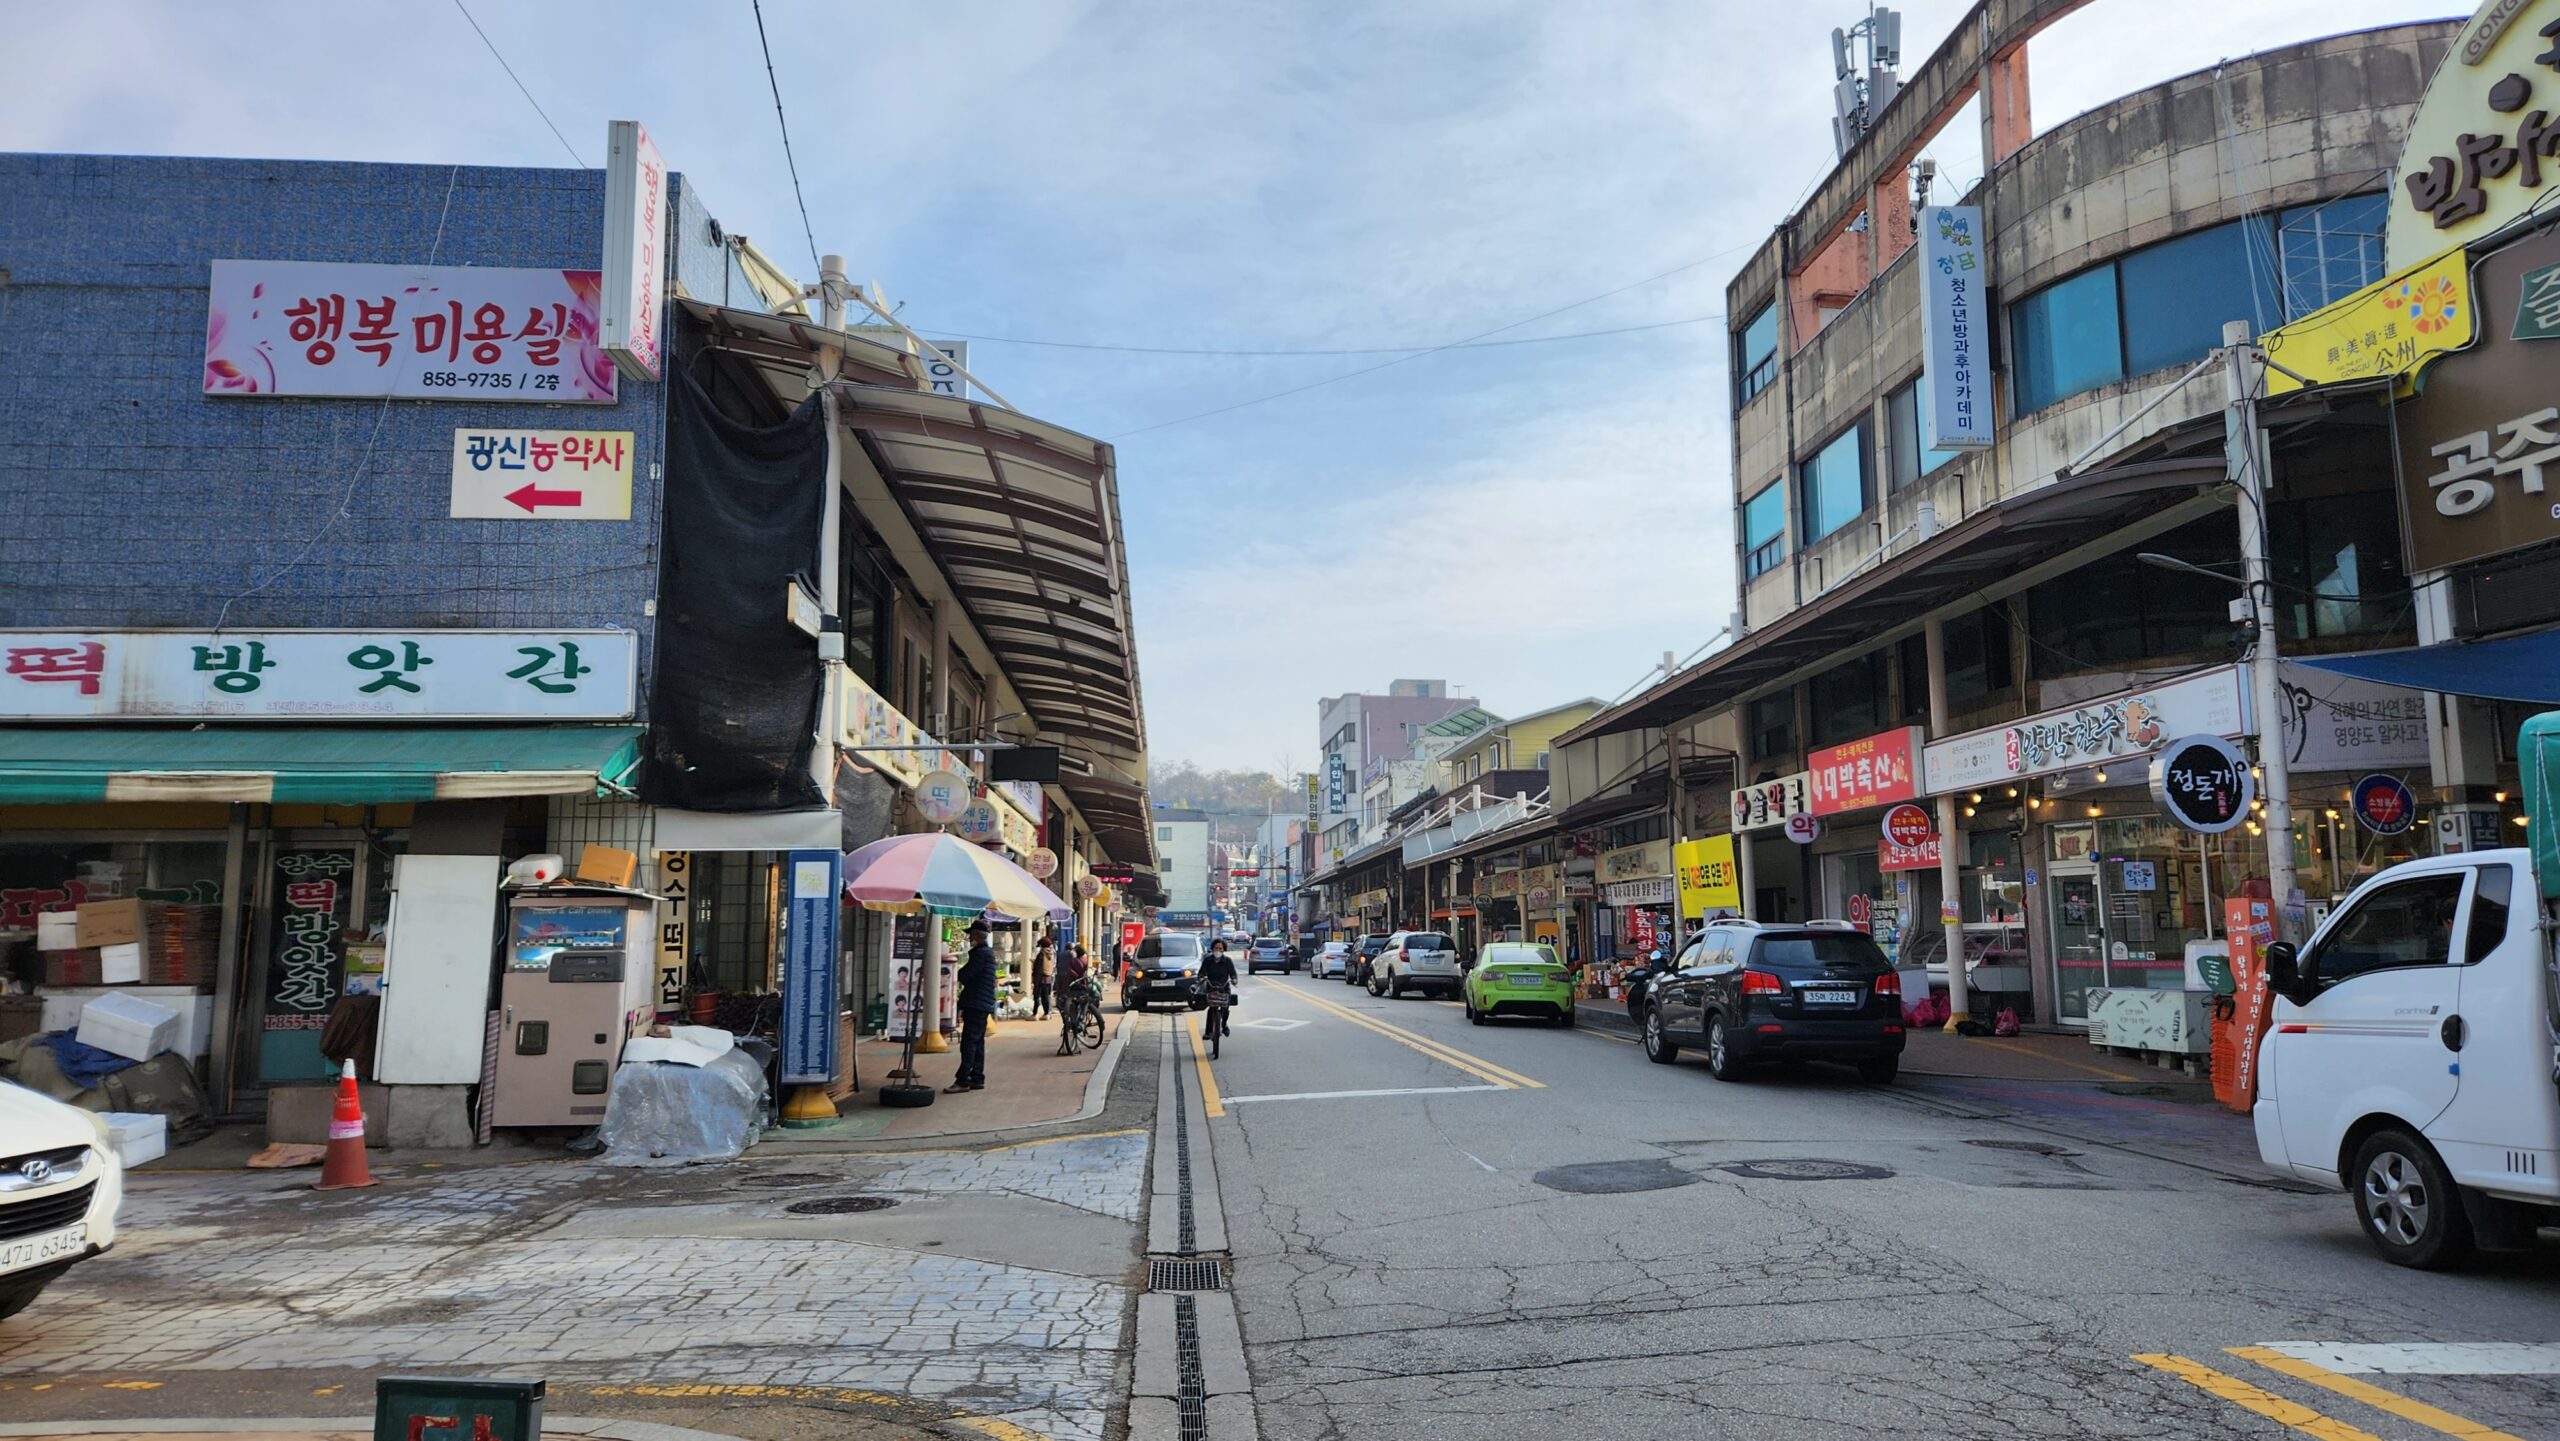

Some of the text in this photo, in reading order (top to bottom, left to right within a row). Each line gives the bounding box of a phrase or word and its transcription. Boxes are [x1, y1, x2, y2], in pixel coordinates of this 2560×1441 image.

[1937, 251, 1976, 275] 청담
[284, 295, 568, 367] 행복 미용실
[1951, 278, 1972, 431] 청소년방과후아카데미
[2375, 336, 2416, 374] 公州
[423, 371, 512, 390] 858-9735
[534, 373, 561, 392] 2층
[466, 436, 625, 472] 광신농약사
[2374, 700, 2401, 718] 자연
[2335, 724, 2420, 747] 영양도 알차고
[1824, 753, 1891, 799] 대박축산
[932, 786, 950, 806] 떡
[1791, 817, 1814, 838] 약
[1891, 826, 1928, 836] 대박축산
[277, 854, 352, 875] 양수
[1830, 992, 1851, 1001] 2242
[2240, 1023, 2255, 1091] 산성시장길
[41, 1231, 78, 1257] 6345
